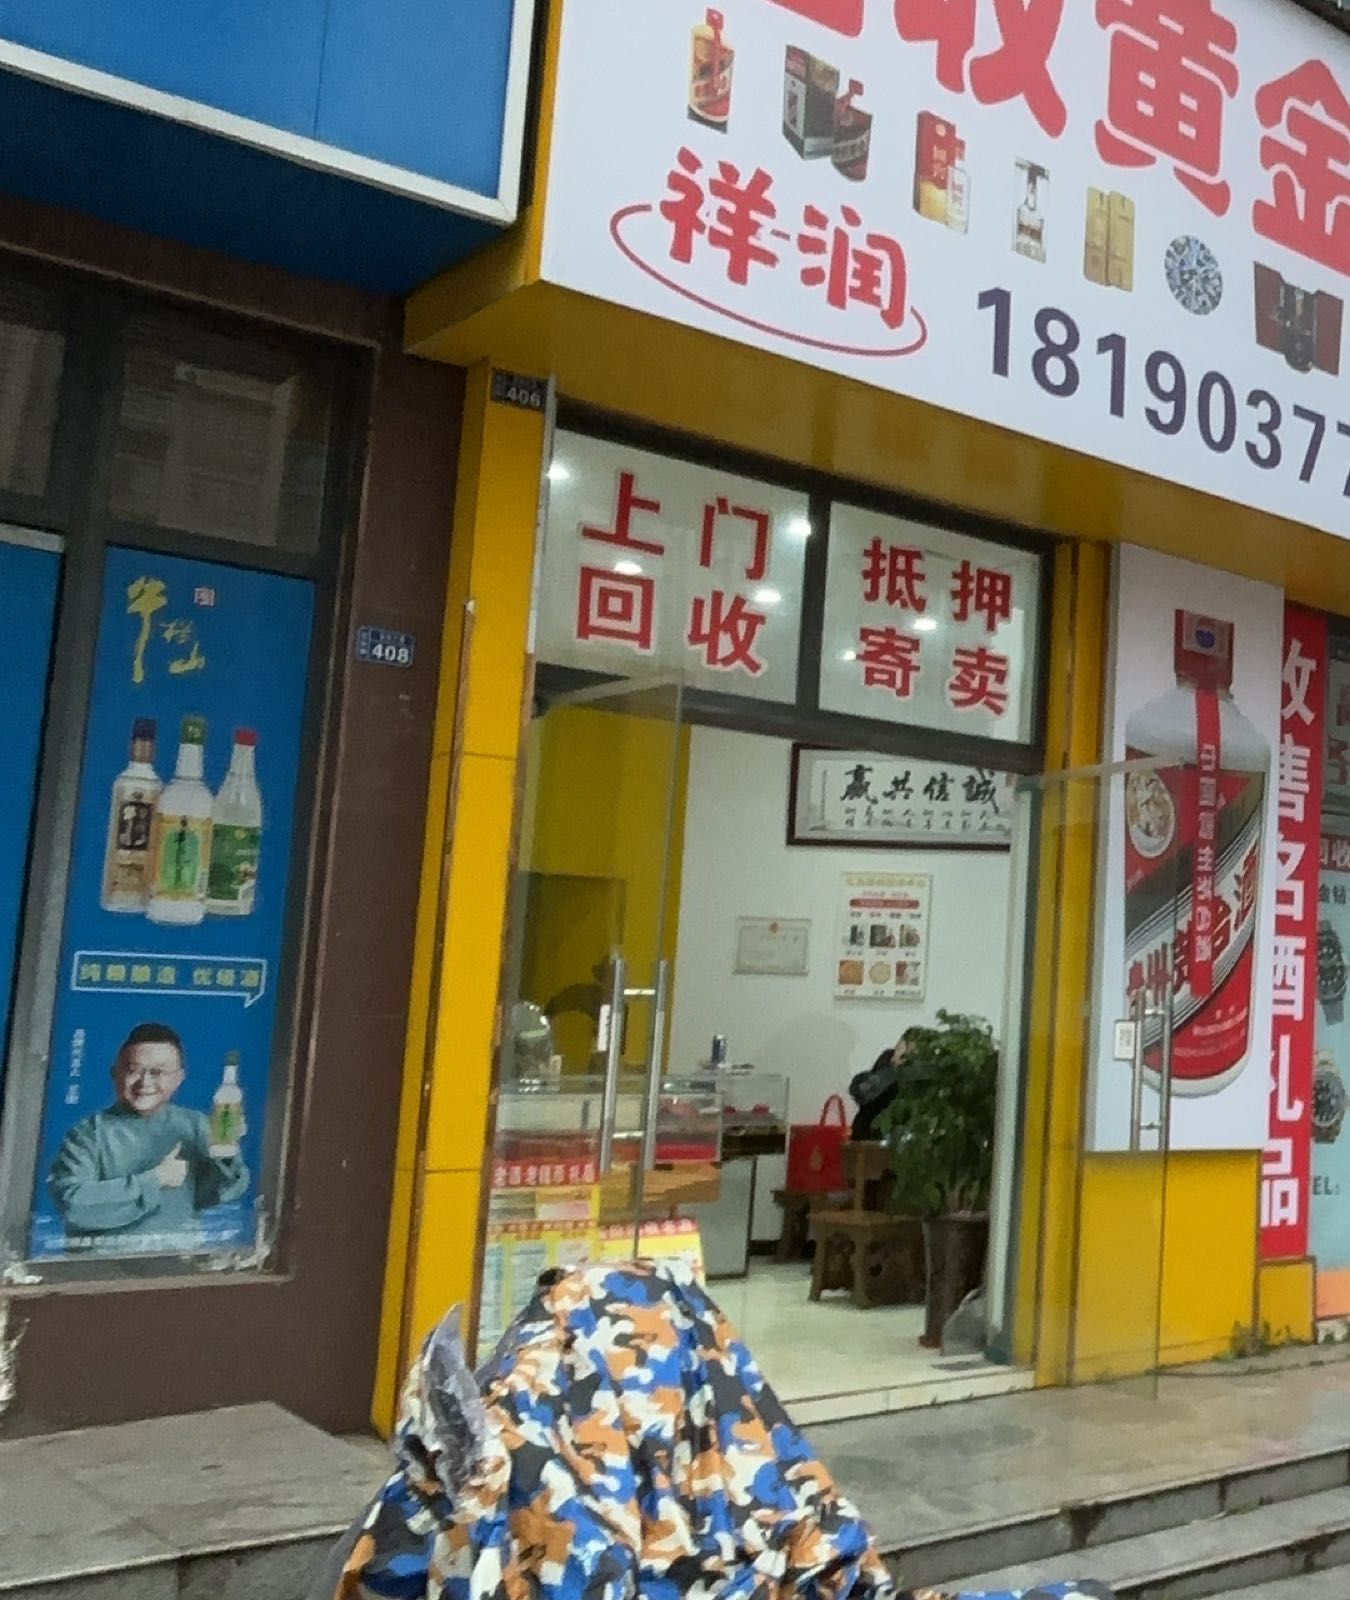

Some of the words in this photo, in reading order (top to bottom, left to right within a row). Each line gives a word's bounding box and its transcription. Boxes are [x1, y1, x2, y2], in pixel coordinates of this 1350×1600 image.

[660, 146, 908, 330] 祥润
[582, 472, 770, 580] 上门
[576, 566, 765, 676] 回收
[862, 536, 1013, 632] 抵押
[373, 644, 409, 664] 408
[856, 626, 1009, 714] 寄卖
